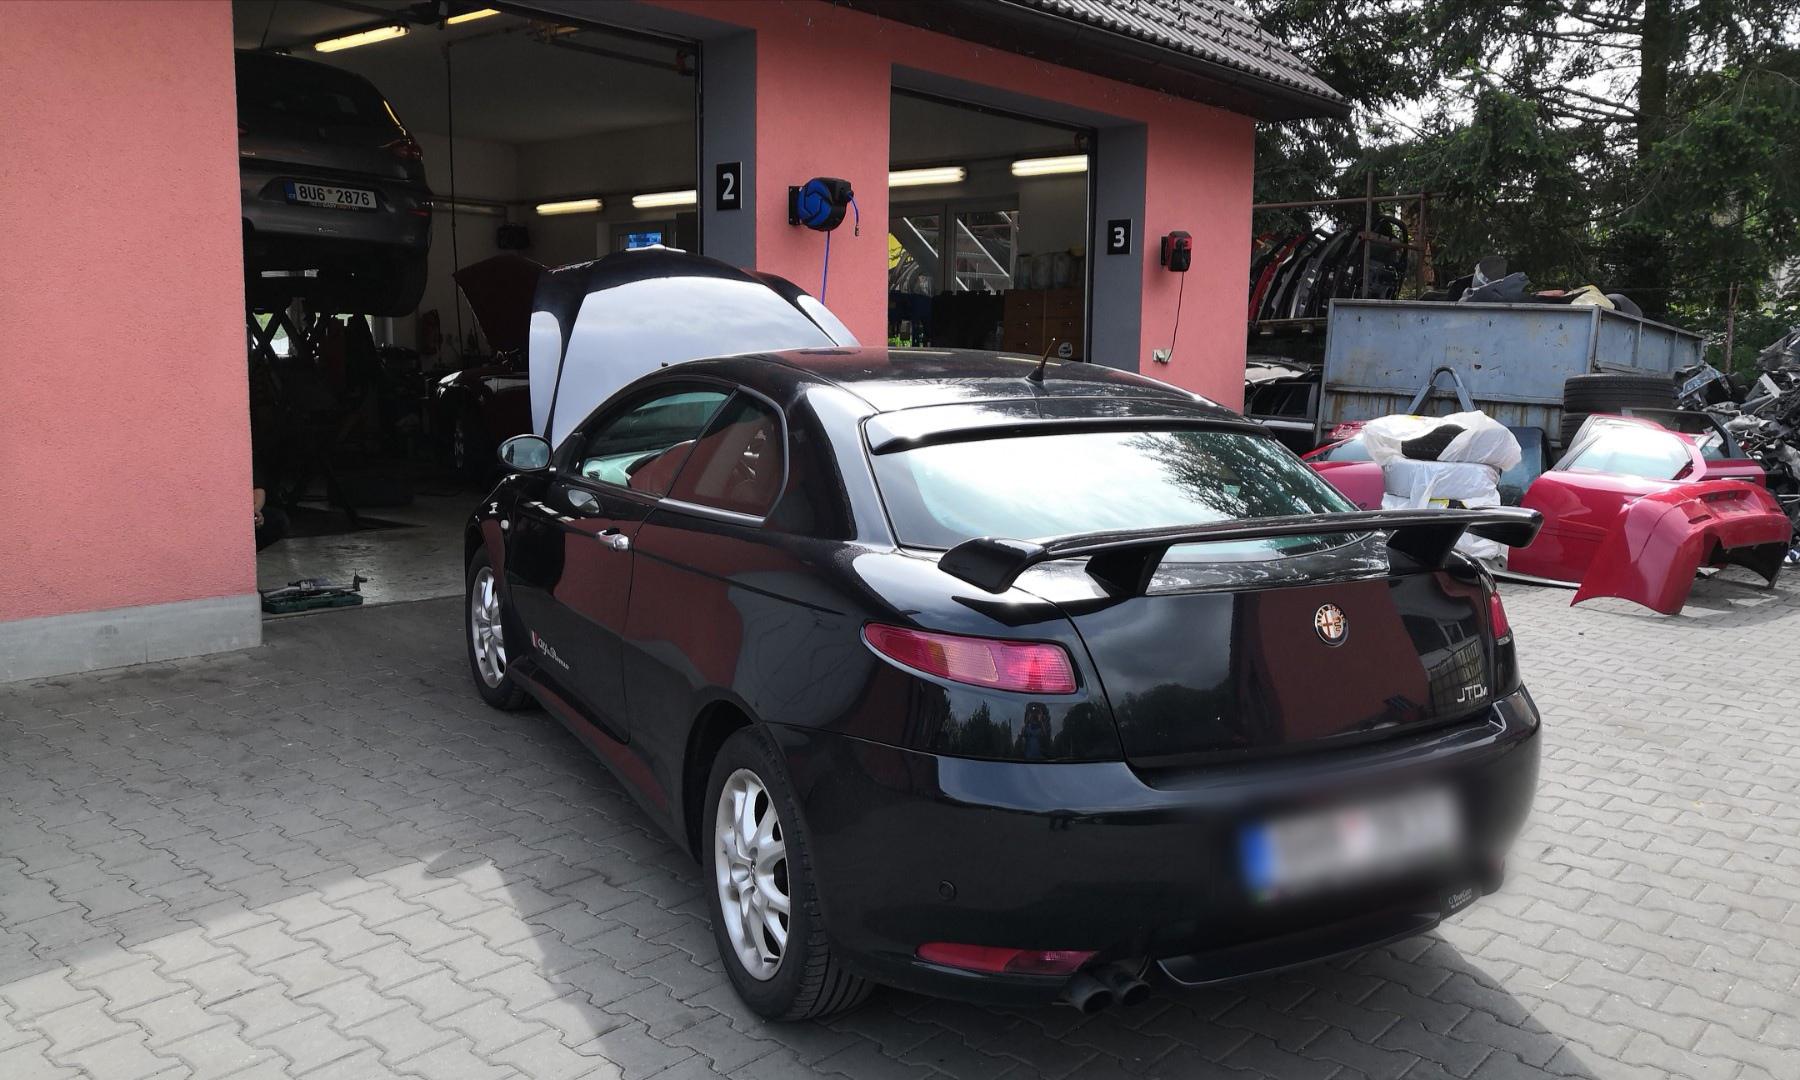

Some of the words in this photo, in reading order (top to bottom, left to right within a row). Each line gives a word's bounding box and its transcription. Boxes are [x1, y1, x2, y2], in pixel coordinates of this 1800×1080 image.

[299, 186, 325, 201] 8U6
[336, 190, 370, 206] 2876
[722, 172, 735, 200] 2
[1113, 226, 1125, 247] 3
